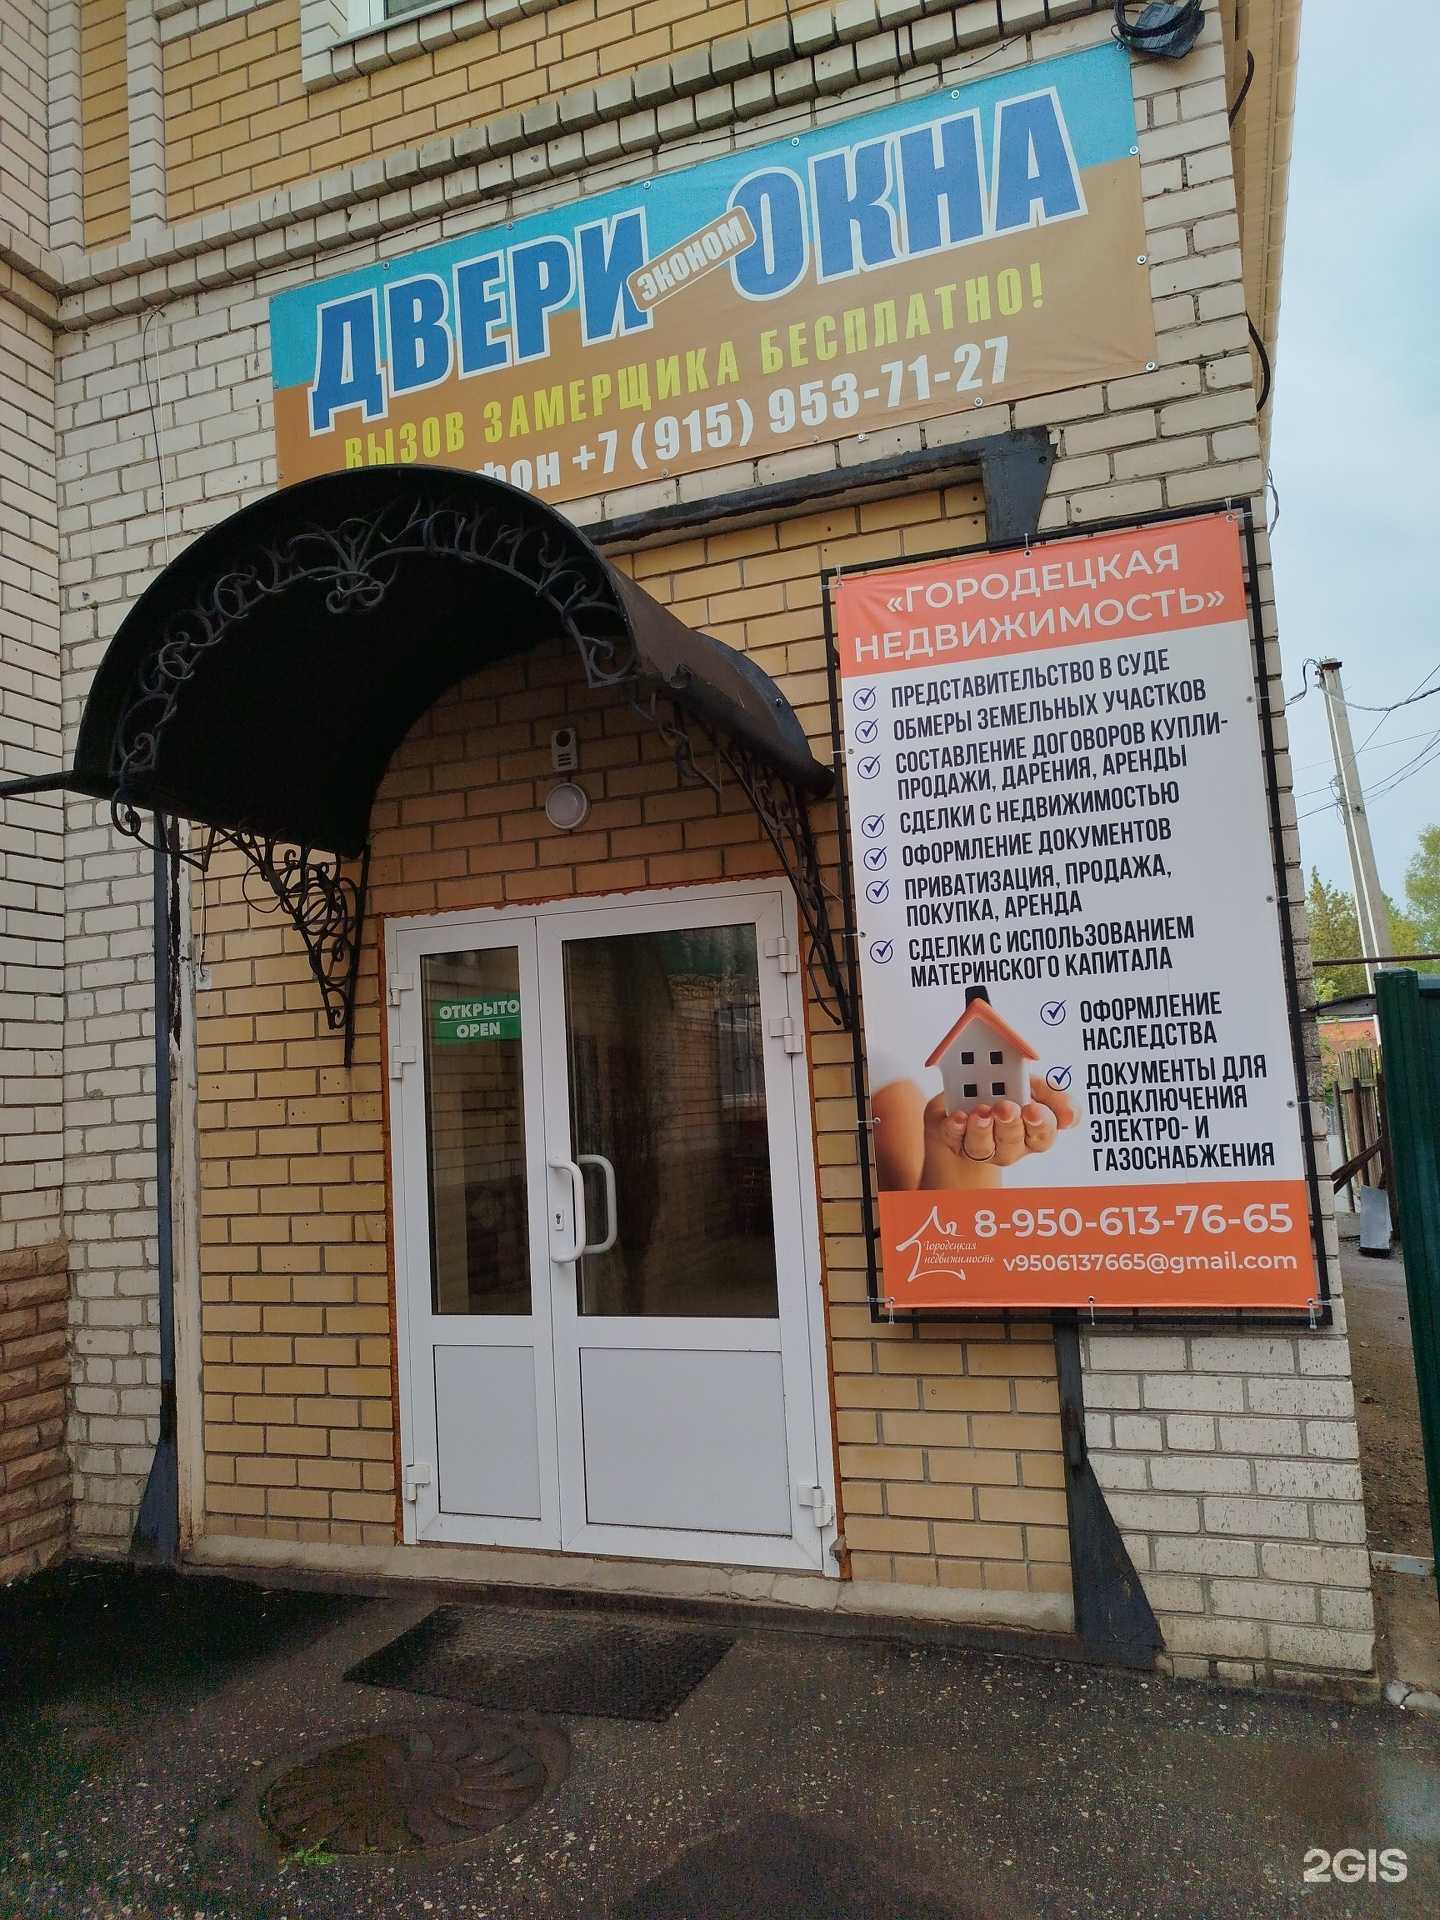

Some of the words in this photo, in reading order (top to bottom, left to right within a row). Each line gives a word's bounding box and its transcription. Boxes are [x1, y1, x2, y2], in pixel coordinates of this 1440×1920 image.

[309, 209, 654, 435] ДВЕРИ
[727, 87, 1088, 302] ОКНА
[636, 218, 747, 302] ЭКОНОМ
[345, 411, 464, 469] ВЫЗОВ
[485, 342, 740, 443] ЗАМЕРЩИКА
[761, 261, 1044, 375] БЕСПЛАТНО!
[572, 429, 617, 475] +7
[632, 398, 754, 472] (915)
[770, 336, 1010, 435] 953-71-27
[886, 544, 1179, 613] «ГОРОДЕЦКАЯ
[856, 588, 1224, 662] НЕДВИЖИМОСТЬ»
[892, 657, 1094, 708] ПРЕДСТАВИТЕЛЬСТВО
[1100, 656, 1113, 677] В
[1117, 649, 1170, 677] СУДЕ
[894, 714, 972, 741] ОБМЕРЫ
[977, 697, 1098, 735] ЗЕМЕЛЬНЫХ
[1104, 679, 1206, 714] УЧАСТКОВ
[896, 739, 1027, 773] СОСТАВЛЕНИЕ
[1032, 722, 1146, 760] ДОГОВОРОВ
[1151, 712, 1228, 747] КУПЛИ-
[898, 770, 997, 801] ПРОДАЖИ,
[1002, 757, 1097, 790] ДАРЕНИЯ,
[1102, 746, 1187, 776] АРЕНДЫ
[900, 806, 975, 834] СДЕЛКИ
[980, 803, 992, 825] С
[997, 781, 1179, 824] НЕДВИЖИМОСТЬЮ
[903, 833, 1032, 866] ОФОРМЛЕНИЕ
[1038, 817, 1171, 856] ДОКУМЕНТОВ
[905, 866, 1061, 900] ПРИВАТИЗАЦИЯ,
[1065, 854, 1171, 886] ПРОДАЖА,
[906, 900, 999, 927] ПОКУПКА,
[1005, 891, 1082, 921] АРЕНДА
[909, 936, 985, 963] СДЕЛКИ
[990, 933, 1002, 954] С
[1007, 916, 1194, 953] ИСПОЛЬЗОВАНИЕМ
[911, 957, 1059, 987] МАТЕРИНСКОГО
[1065, 947, 1173, 977] КАПИТАЛА
[440, 1000, 520, 1019] ОТКРЫТО
[456, 1022, 501, 1038] OPEN
[1080, 992, 1222, 1023] ОФОРМЛЕНИЕ
[1083, 1021, 1217, 1051] НАСЛЕДСТВА
[1086, 1059, 1216, 1090] ДОКУМЕНТЫ
[1222, 1054, 1267, 1082] ДЛЯ
[1089, 1085, 1247, 1117] ПОДКЛЮЧЕНИЯ
[1091, 1117, 1188, 1143] ЭЛЕКТРО-
[1195, 1116, 1209, 1138] И
[1093, 1143, 1275, 1172] ГАЗОСНАБЖЕНИЯ
[974, 1203, 1293, 1238] 8-950-613-76-65
[1003, 1251, 1298, 1274] v9506137665@gmail.com
